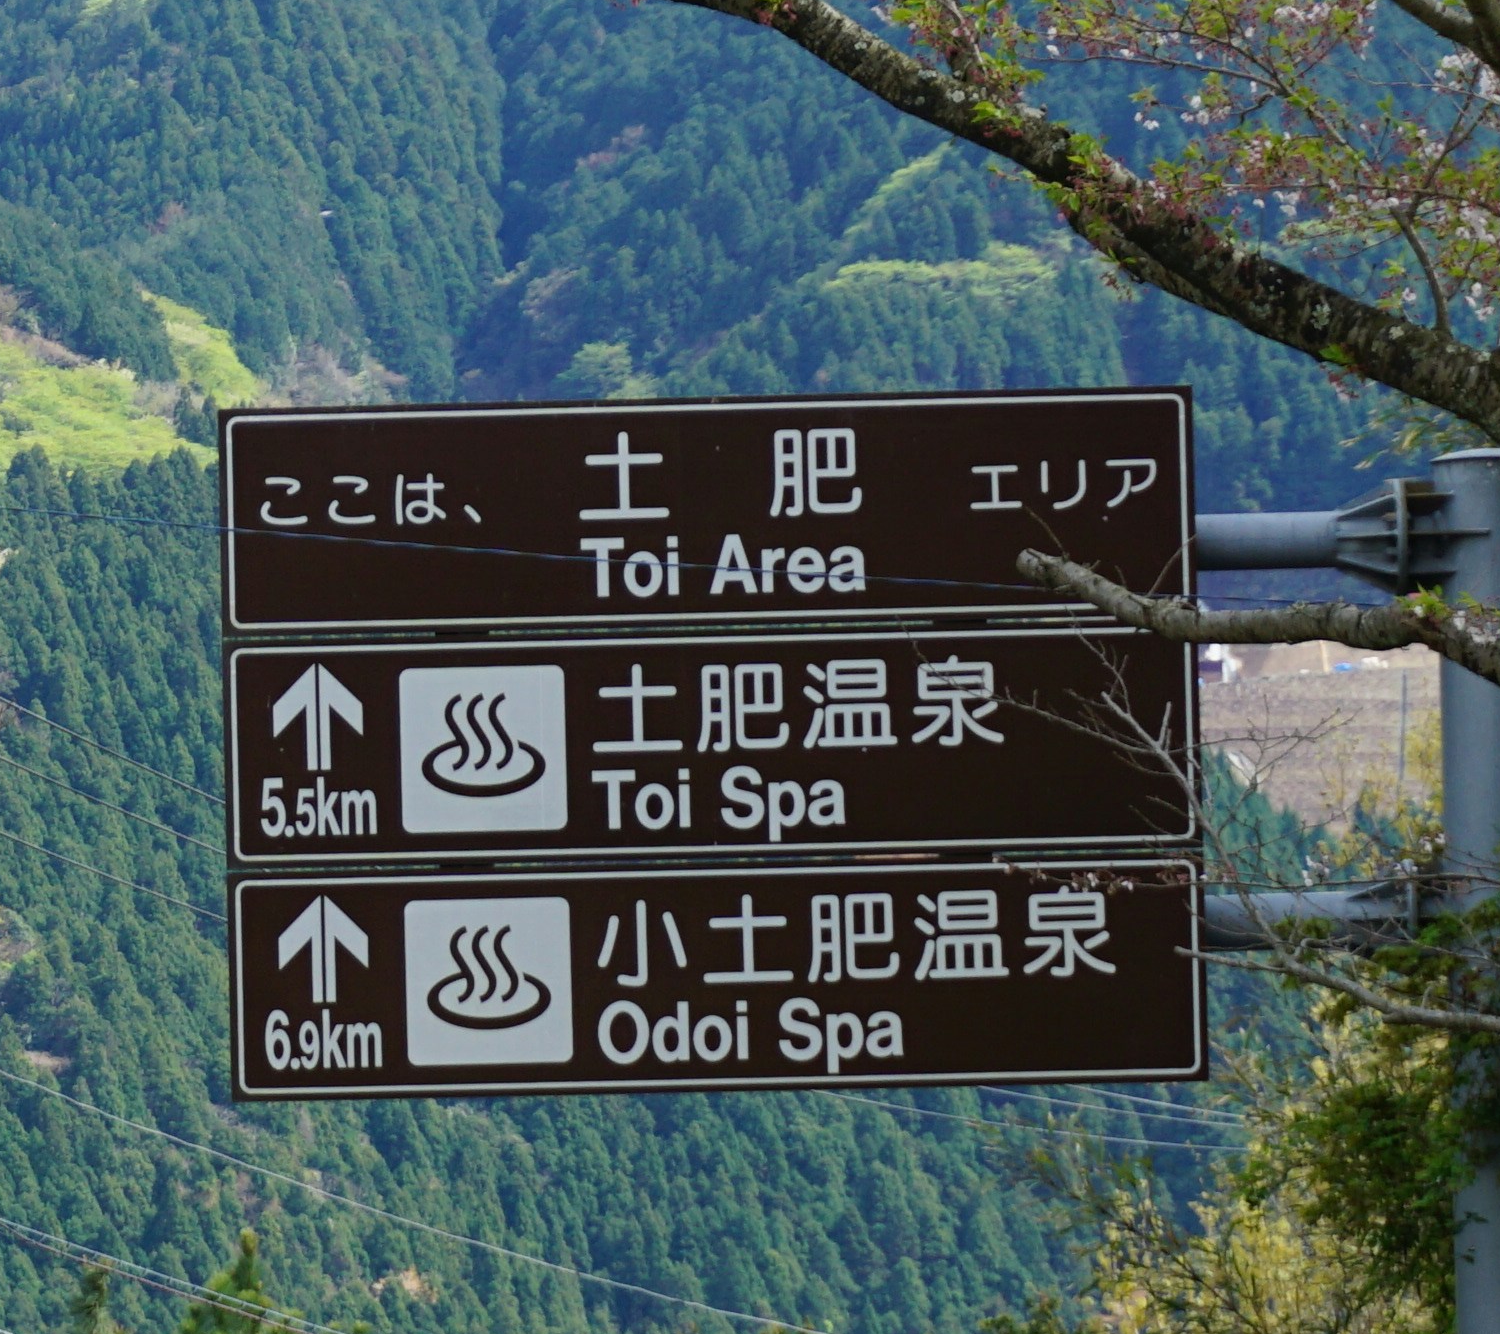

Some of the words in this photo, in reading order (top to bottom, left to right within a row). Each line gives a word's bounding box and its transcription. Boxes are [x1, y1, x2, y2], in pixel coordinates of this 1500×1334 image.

[260, 473, 482, 526] ここは、
[970, 458, 1158, 511] エリア
[580, 535, 681, 599] Toi
[710, 533, 866, 595] Area
[592, 655, 1005, 754] 土肥温泉
[260, 776, 378, 838] 5.5km
[591, 768, 692, 831] Toi
[720, 765, 848, 843] Spa
[597, 885, 1117, 987] 小土肥温泉
[265, 1008, 384, 1070] 6.9km
[598, 999, 749, 1065] Odoi
[778, 996, 906, 1074] Spa
